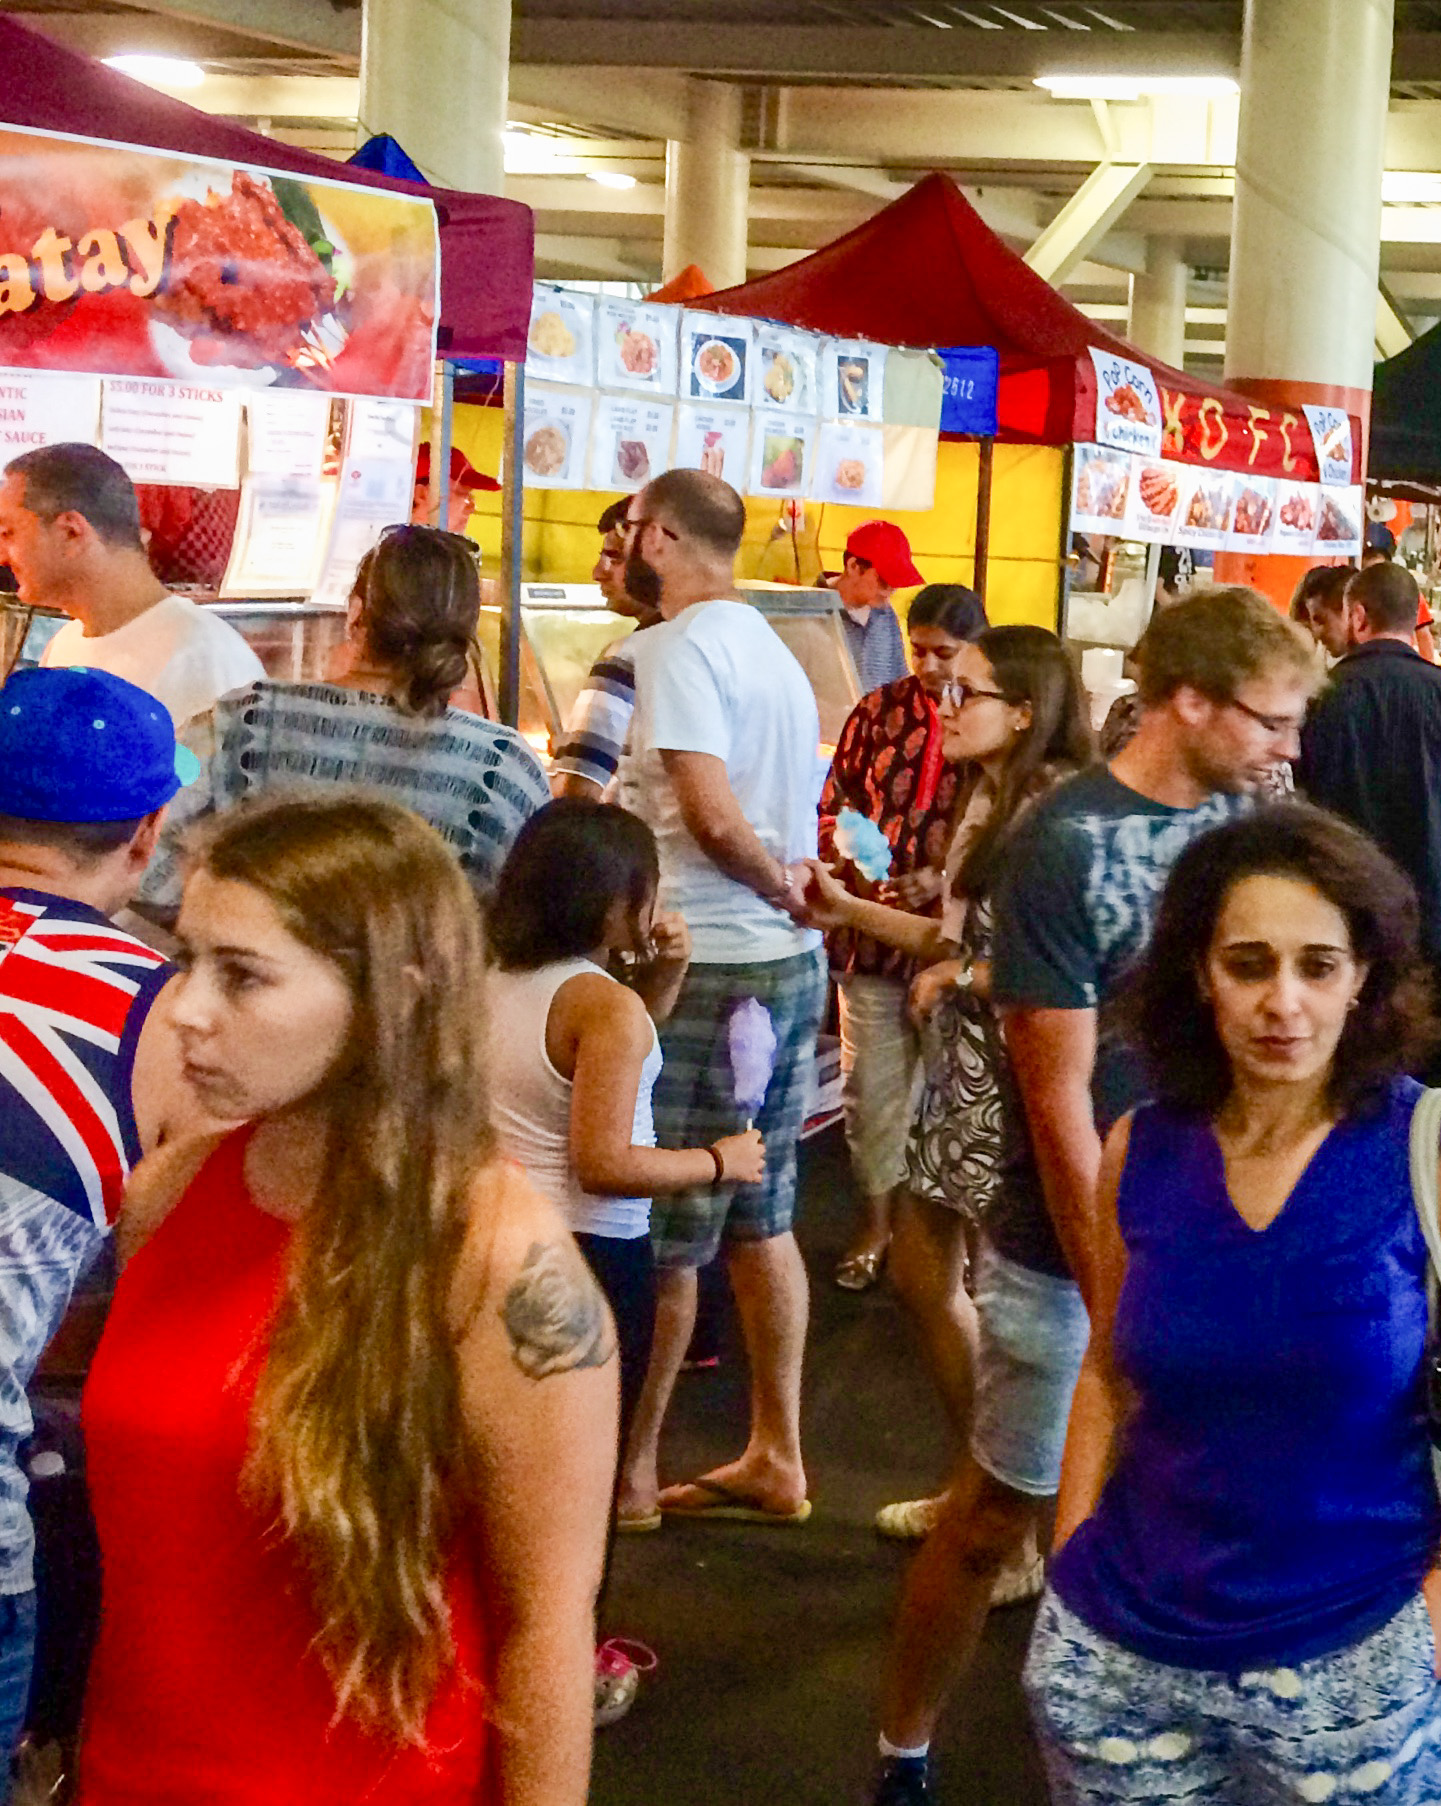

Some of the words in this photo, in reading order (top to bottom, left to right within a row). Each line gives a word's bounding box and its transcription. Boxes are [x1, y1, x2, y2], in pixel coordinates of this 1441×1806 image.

[141, 381, 165, 397] FOR
[168, 385, 176, 397] 3
[179, 387, 224, 403] STICKS
